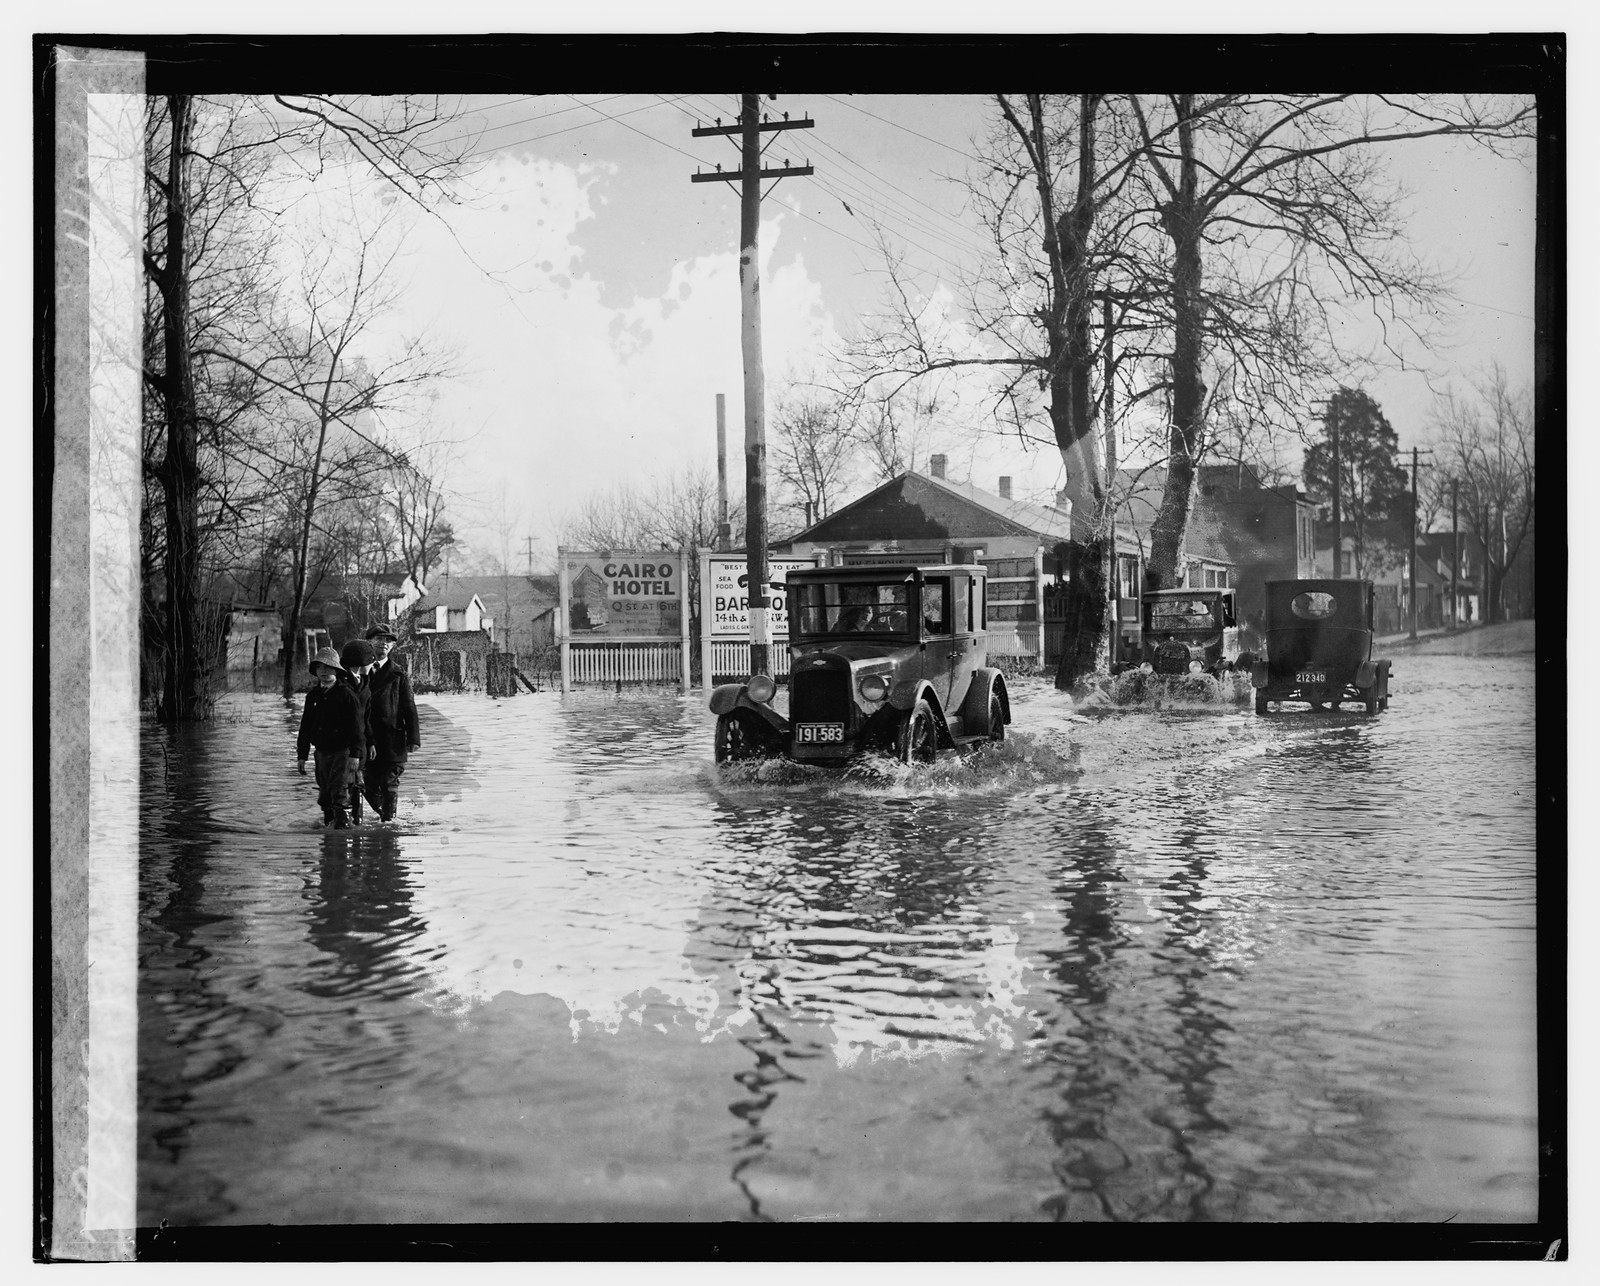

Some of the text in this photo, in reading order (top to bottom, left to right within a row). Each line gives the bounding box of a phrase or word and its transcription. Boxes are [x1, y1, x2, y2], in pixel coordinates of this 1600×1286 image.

[603, 563, 673, 578] CAIRO
[613, 581, 675, 595] HOTEL
[612, 601, 622, 612] Q
[641, 602, 655, 611] AT
[715, 613, 739, 622] 14th
[799, 728, 842, 741] 191-583
